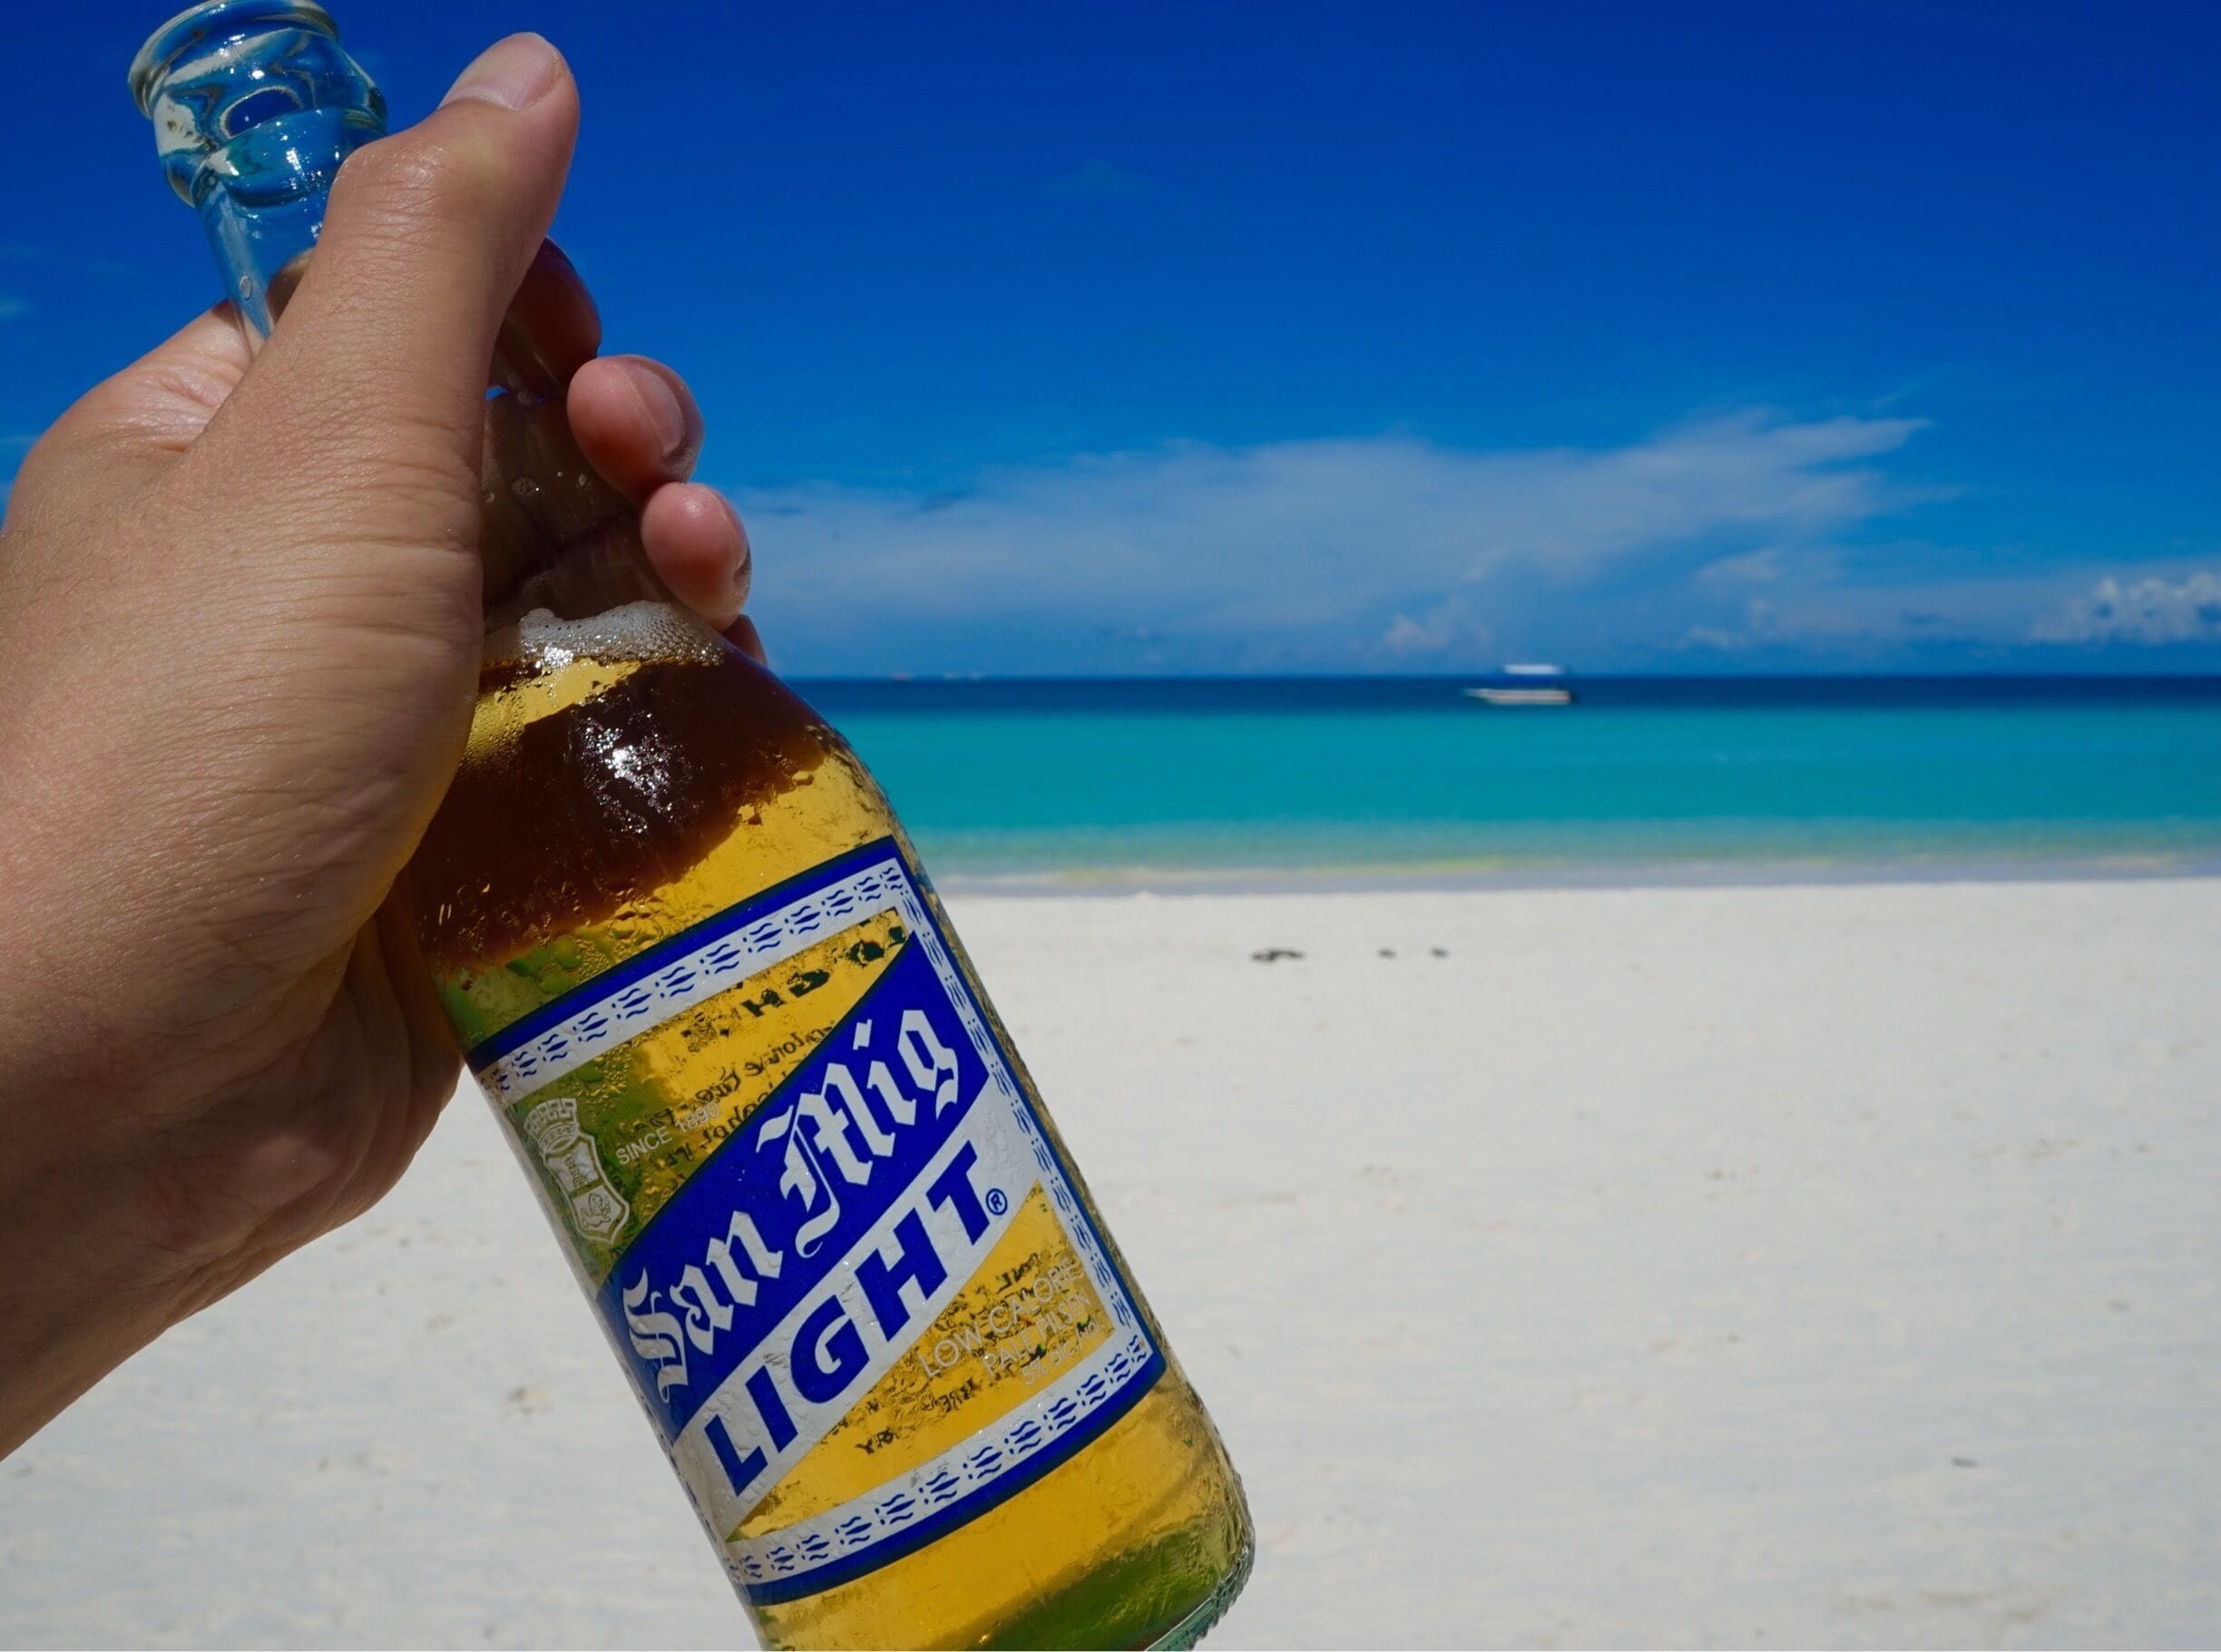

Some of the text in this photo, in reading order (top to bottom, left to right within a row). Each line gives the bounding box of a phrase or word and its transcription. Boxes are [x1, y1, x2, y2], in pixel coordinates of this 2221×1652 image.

[615, 1101, 720, 1165] SINCE 1890
[622, 1210, 783, 1403] San
[756, 1010, 959, 1257] Mig
[704, 1140, 990, 1497] LIGHT
[919, 1257, 1079, 1378] LOW CALORIE
[983, 1292, 1091, 1376] PALE PILSEN
[1021, 1357, 1049, 1386] 5%
